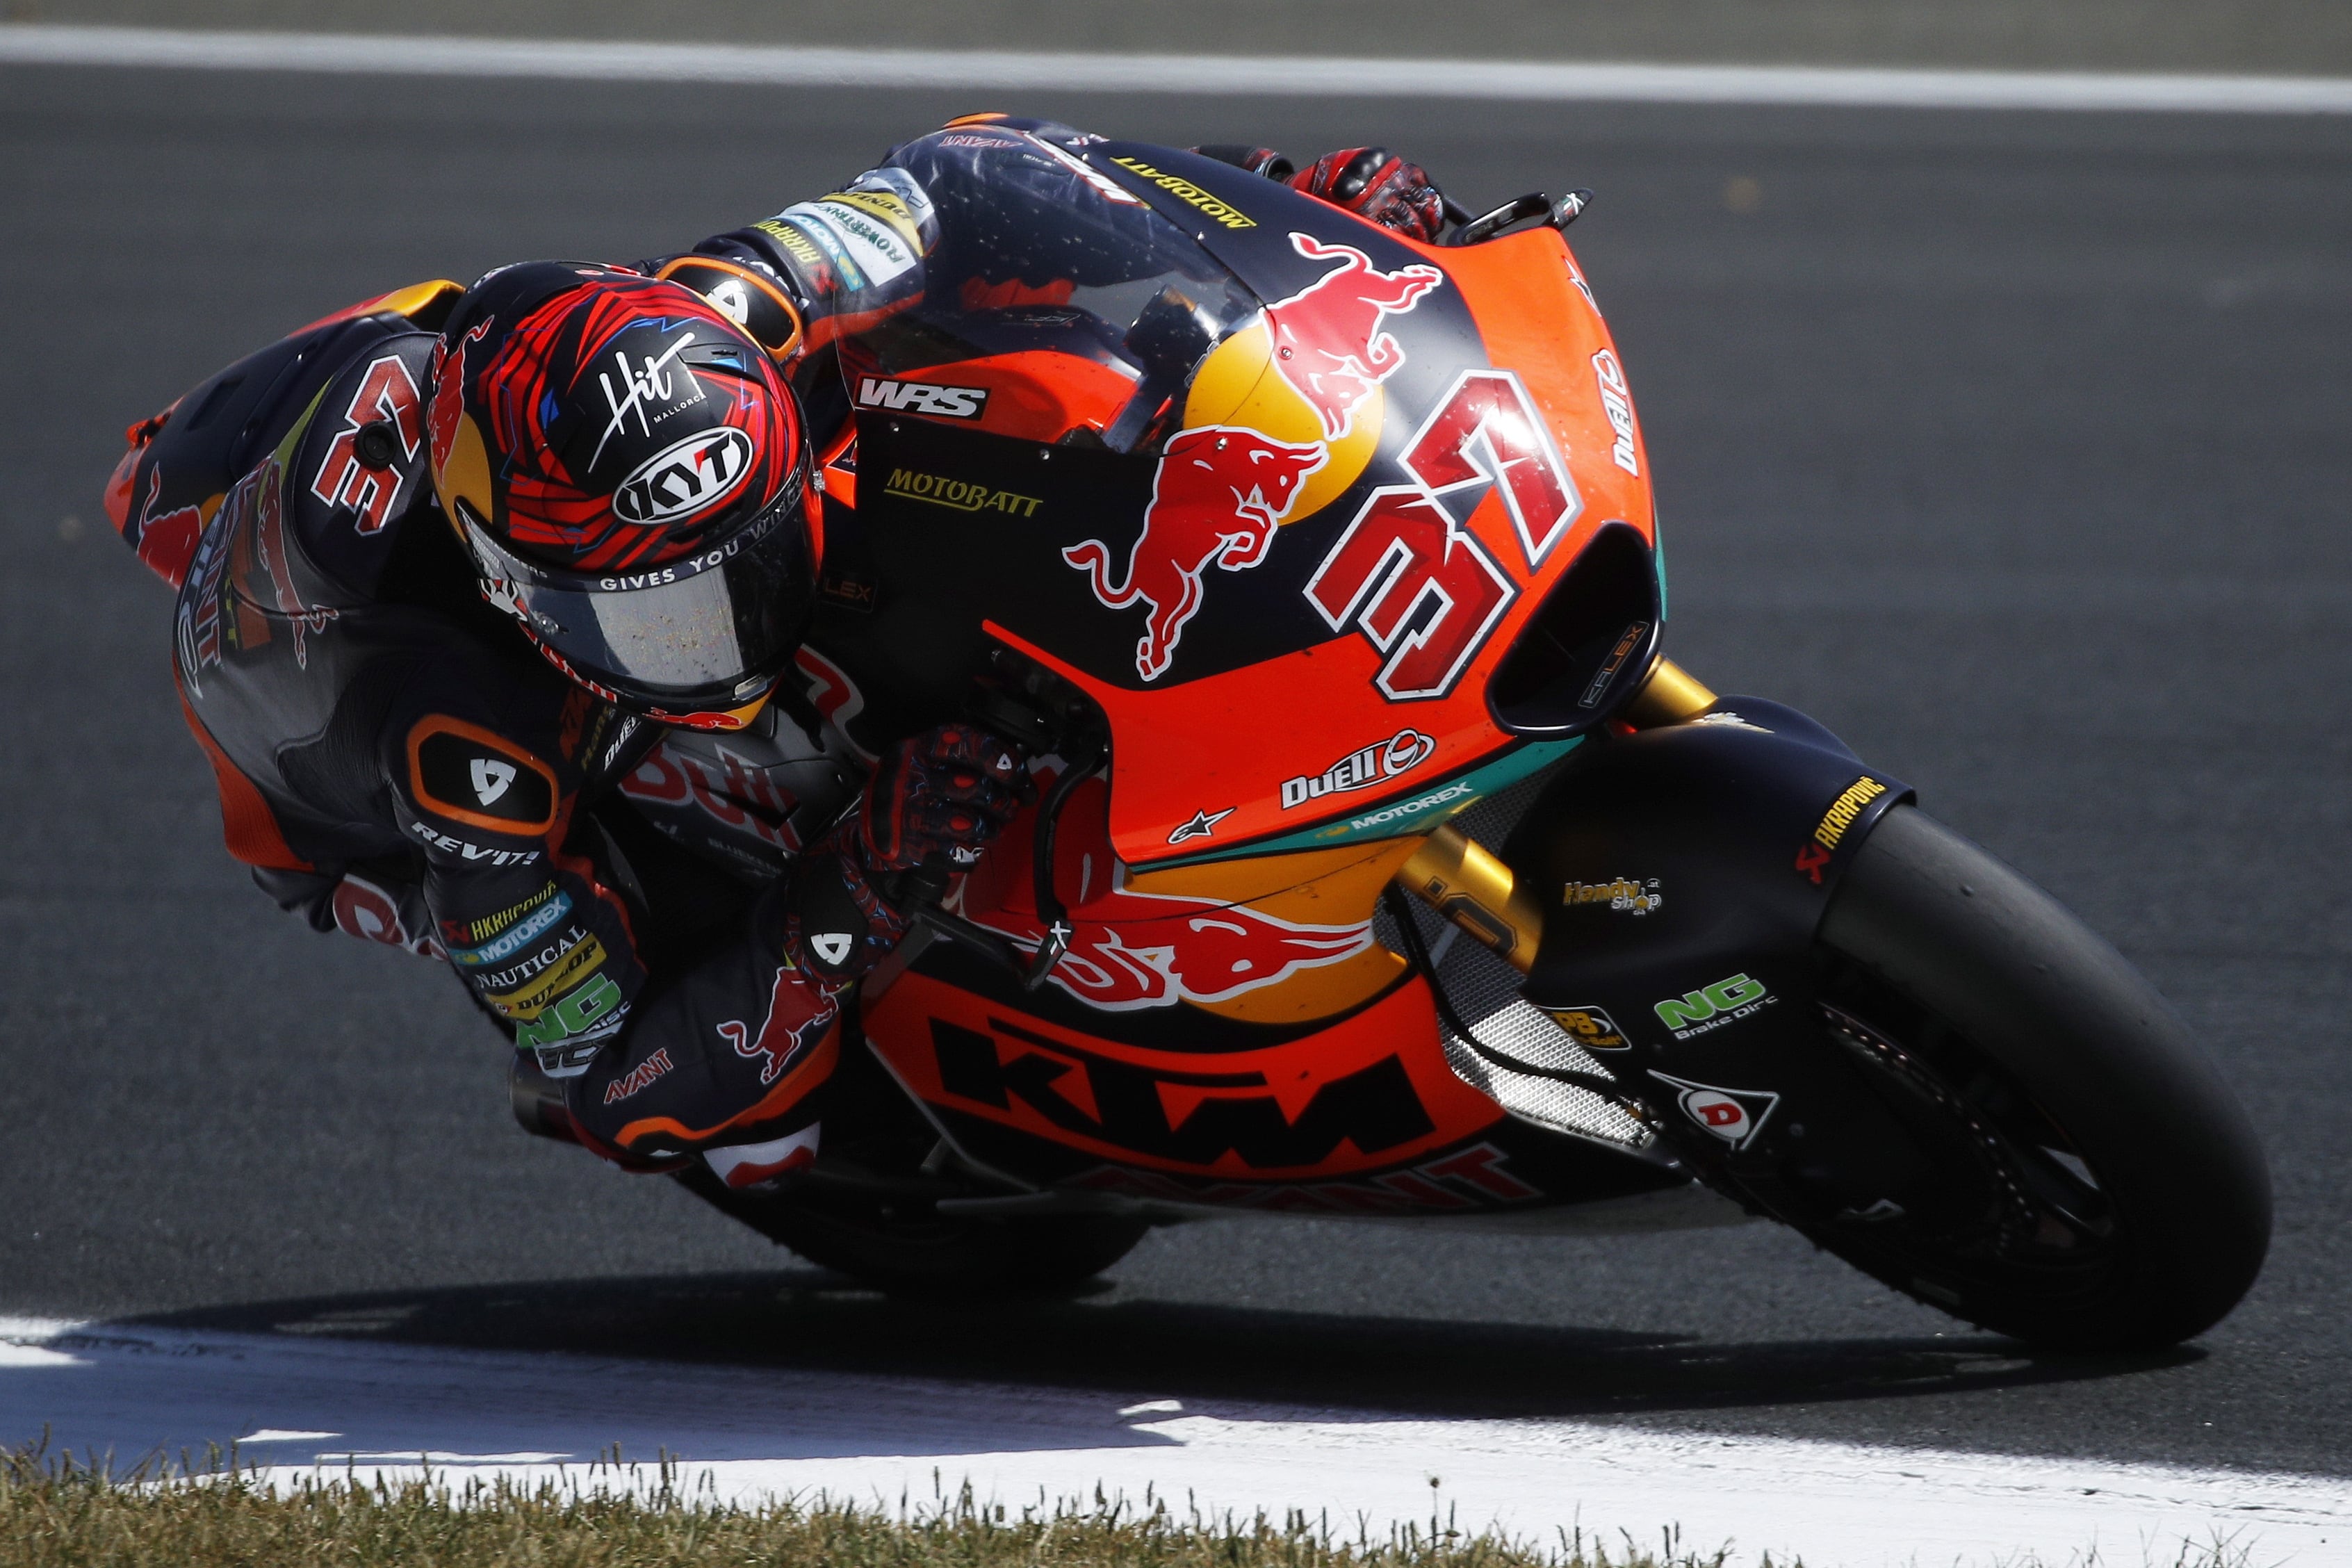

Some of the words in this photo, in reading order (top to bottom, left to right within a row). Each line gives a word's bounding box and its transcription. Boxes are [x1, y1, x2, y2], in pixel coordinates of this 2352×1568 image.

[1109, 156, 1257, 228] MOTOBATT
[588, 332, 695, 473] Hit
[653, 391, 707, 424] MALLORCA
[858, 378, 988, 417] WRS
[625, 430, 733, 520] KYT
[884, 468, 1043, 518] MOTOBATT
[1302, 368, 1578, 699] 37
[600, 567, 676, 591] GIVES
[689, 539, 740, 573] YOU
[823, 580, 873, 603] LEX
[1583, 625, 1644, 704] KALEX
[1350, 781, 1473, 831] MOTOREX
[411, 821, 539, 867] REV'IT!
[1562, 876, 1641, 906] Handy
[477, 901, 569, 964] MOTOREX
[477, 924, 587, 991] NAUTICAL
[516, 972, 622, 1048] NG
[1653, 972, 1767, 1031] NG
[1672, 1015, 1734, 1041] Brake
[603, 1047, 674, 1105] AVANT
[929, 1015, 1437, 1177] KTM
